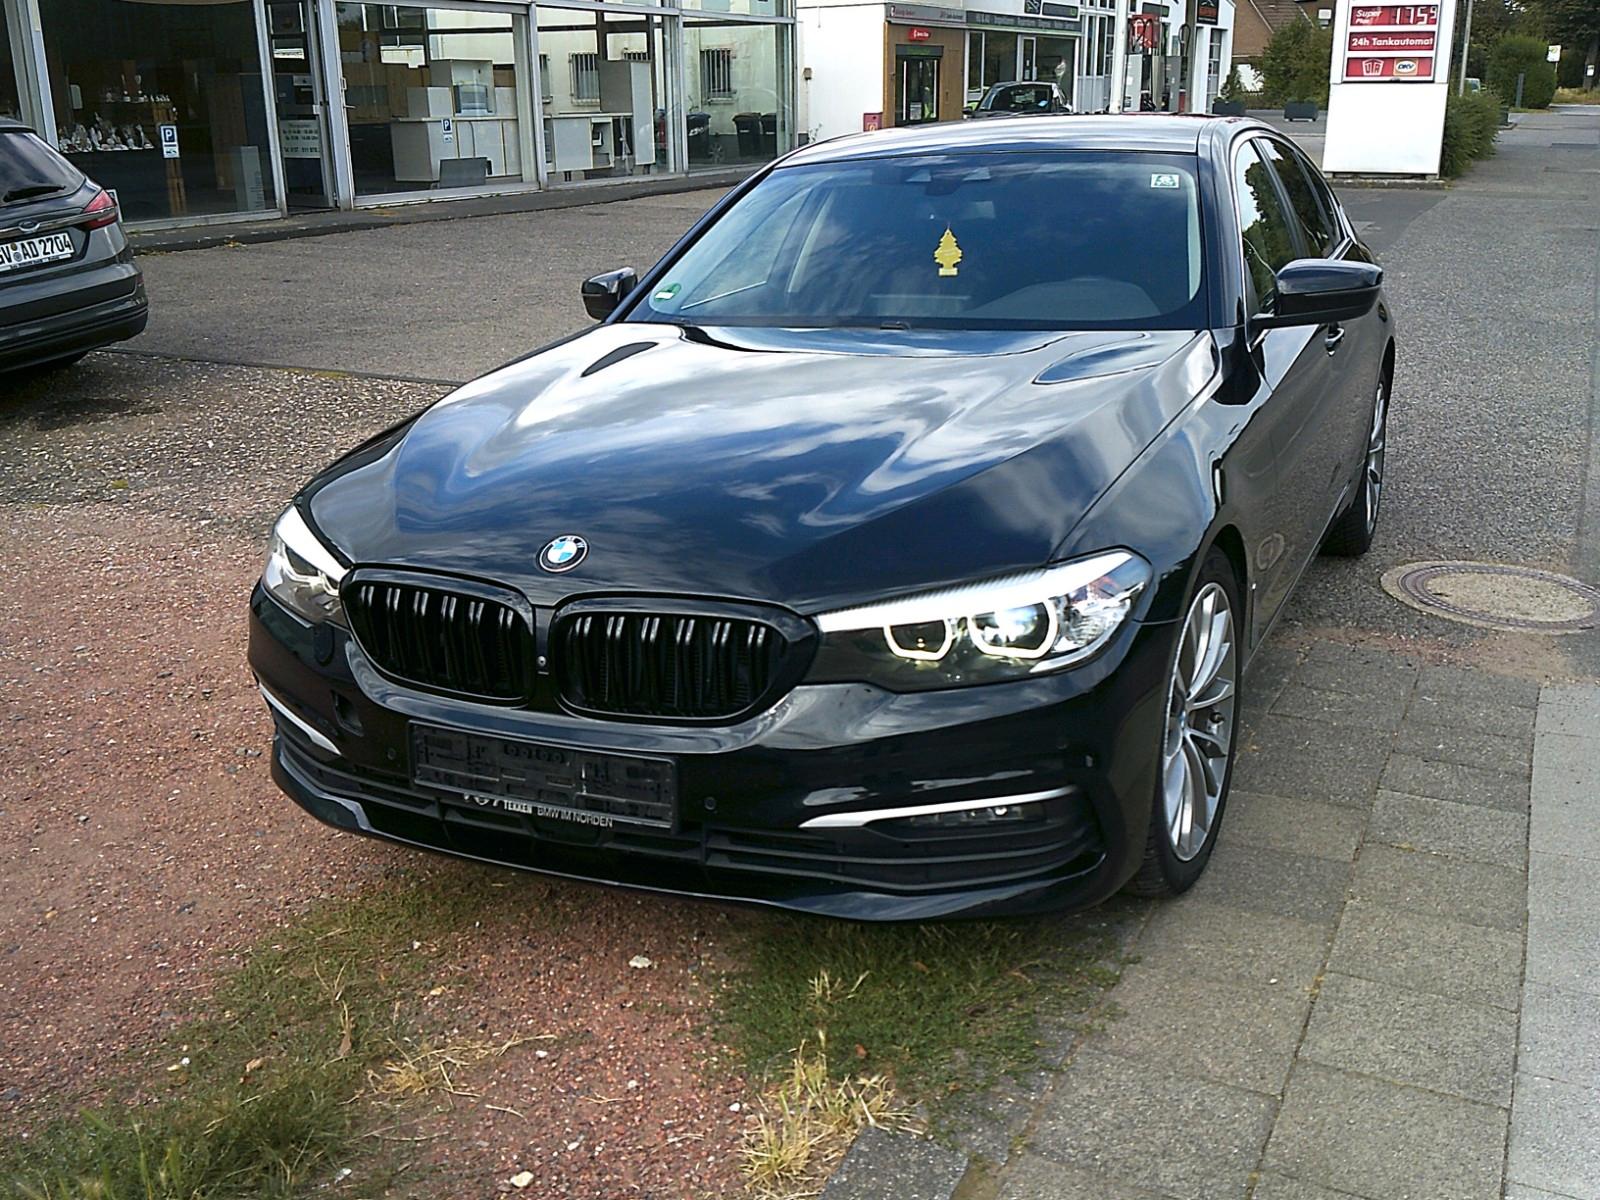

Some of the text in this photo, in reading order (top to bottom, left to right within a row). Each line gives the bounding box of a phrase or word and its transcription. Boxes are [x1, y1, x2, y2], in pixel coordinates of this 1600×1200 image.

[1355, 9, 1382, 18] Super
[1352, 36, 1434, 46] 24h Tankautomat
[165, 129, 173, 141] P
[21, 240, 40, 261] AD
[40, 234, 73, 255] 2704
[572, 811, 614, 828] NORDEN
